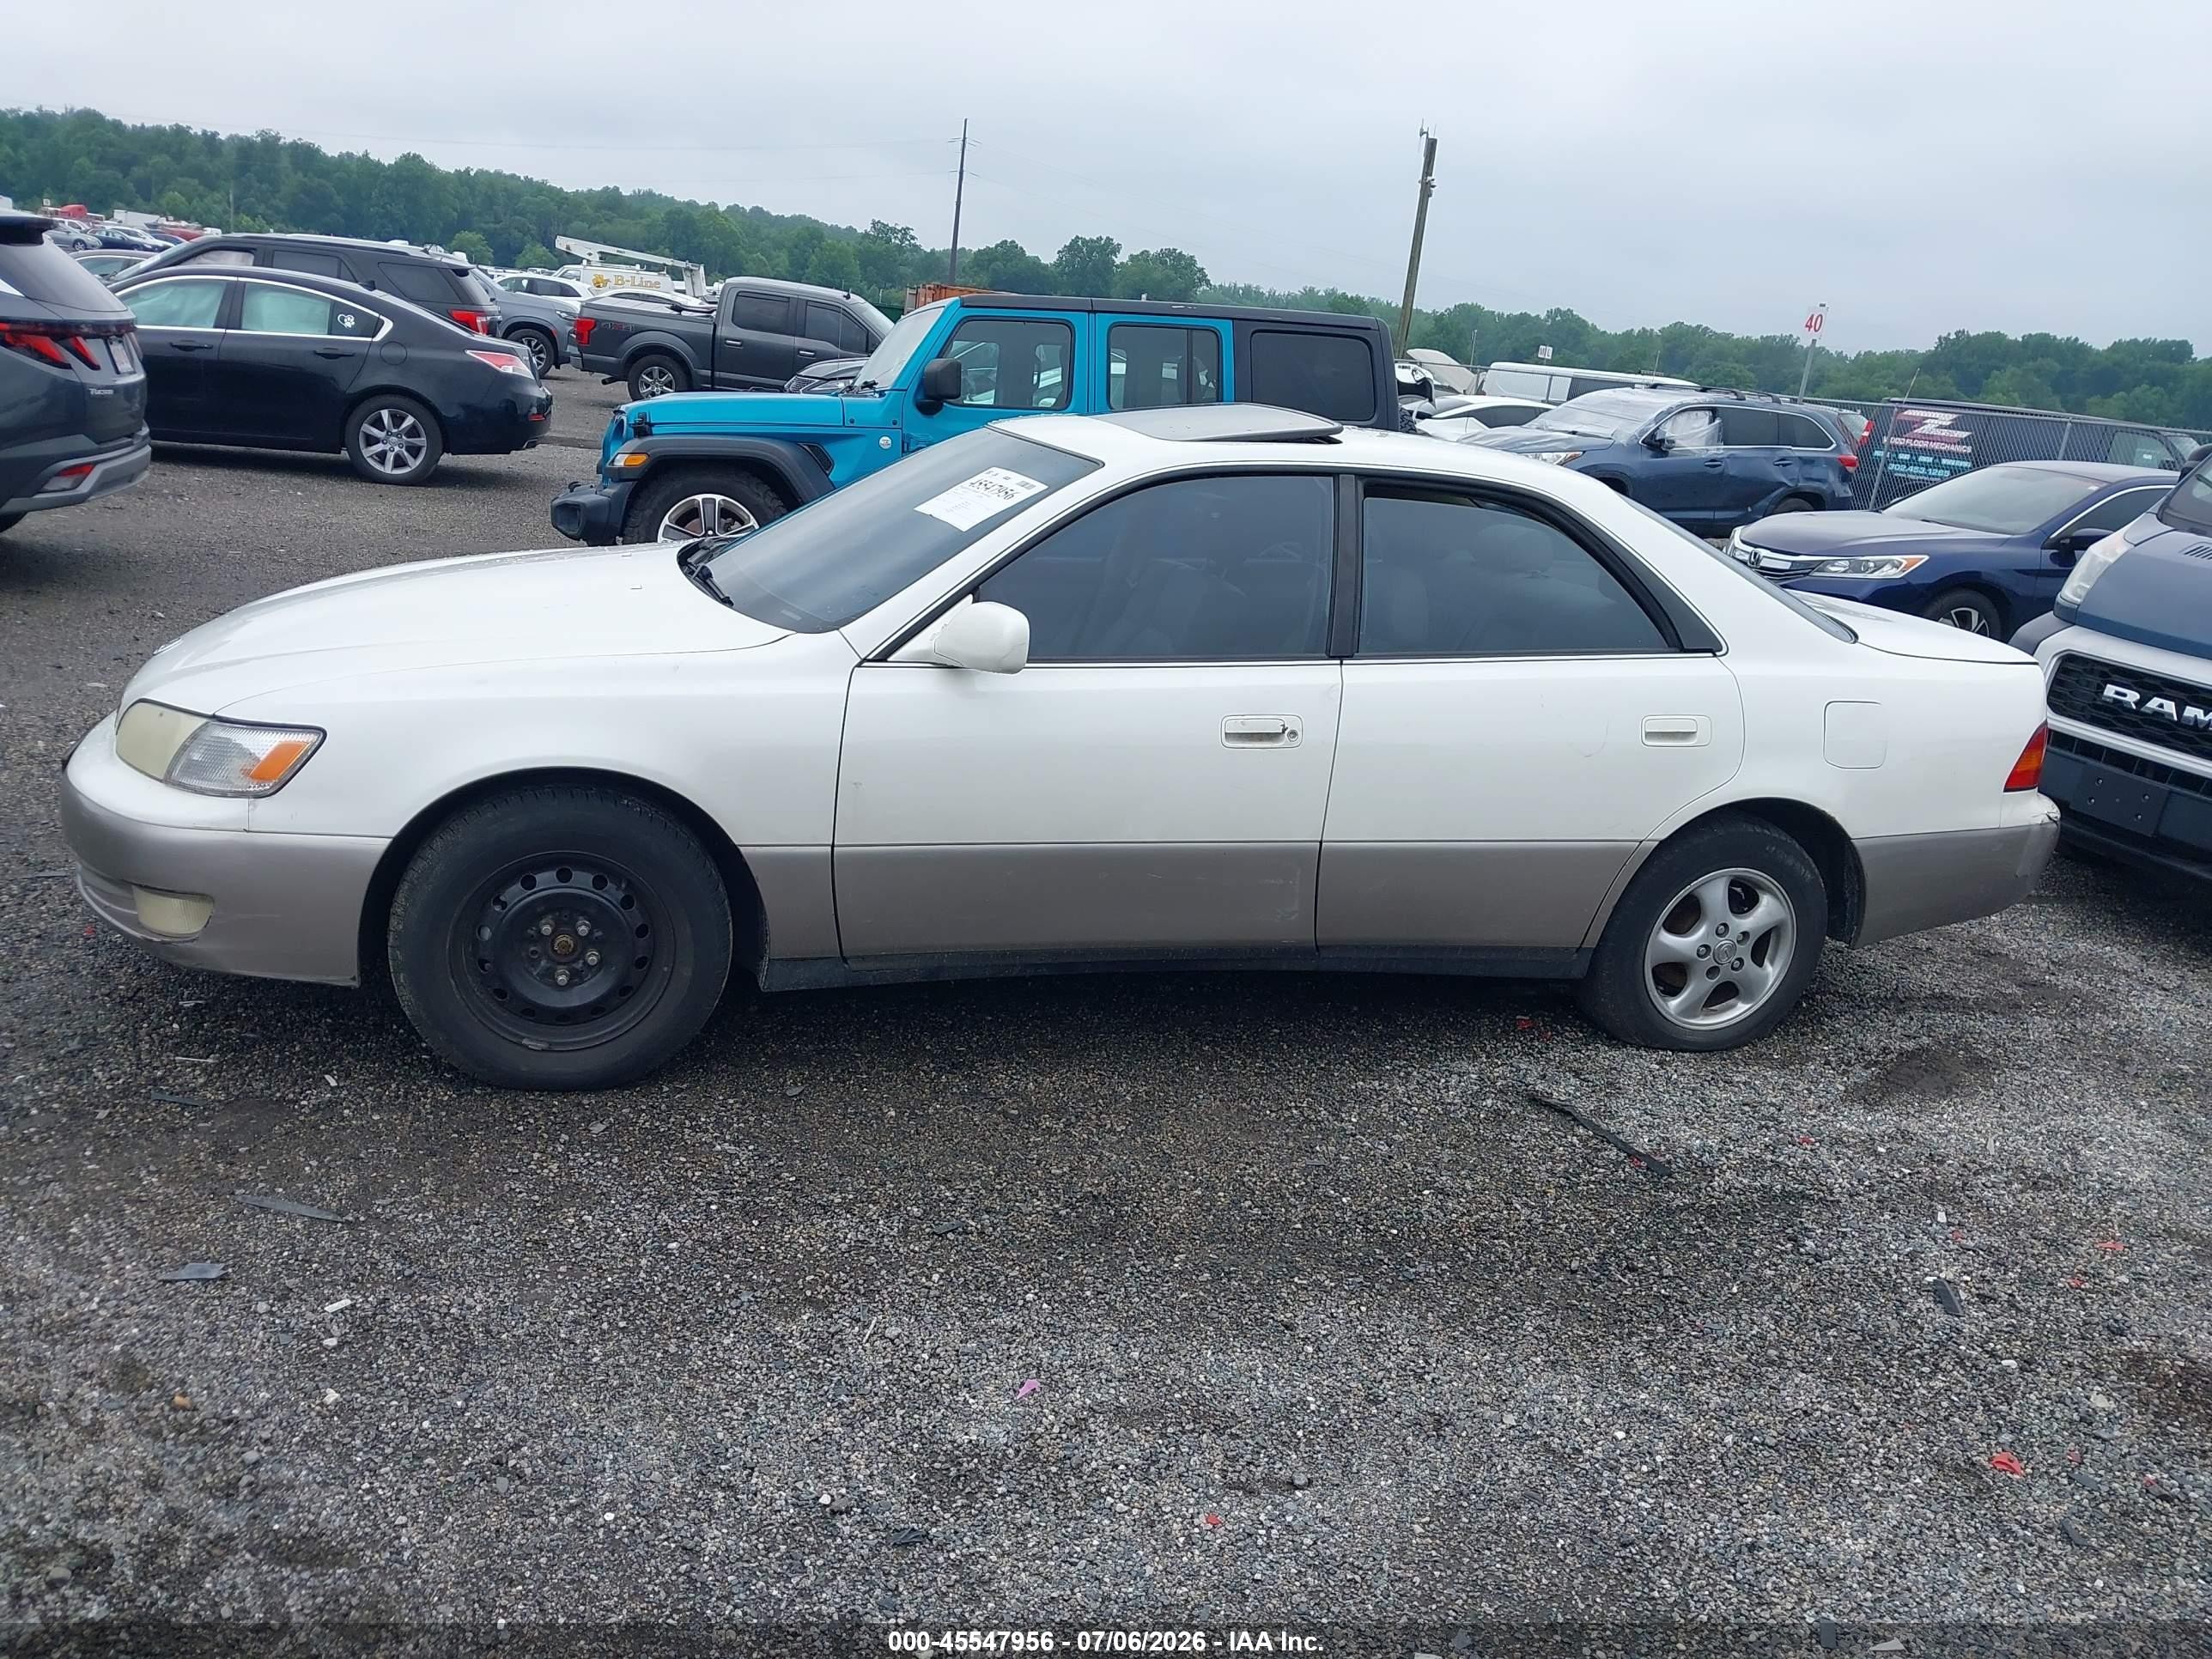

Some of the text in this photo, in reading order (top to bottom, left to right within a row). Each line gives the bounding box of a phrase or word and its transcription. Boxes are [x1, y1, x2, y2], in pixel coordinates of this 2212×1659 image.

[613, 274, 661, 289] B-Line
[1805, 313, 1823, 332] 40
[1905, 439, 1929, 447] FLOOR
[2103, 684, 2212, 730] RAM
